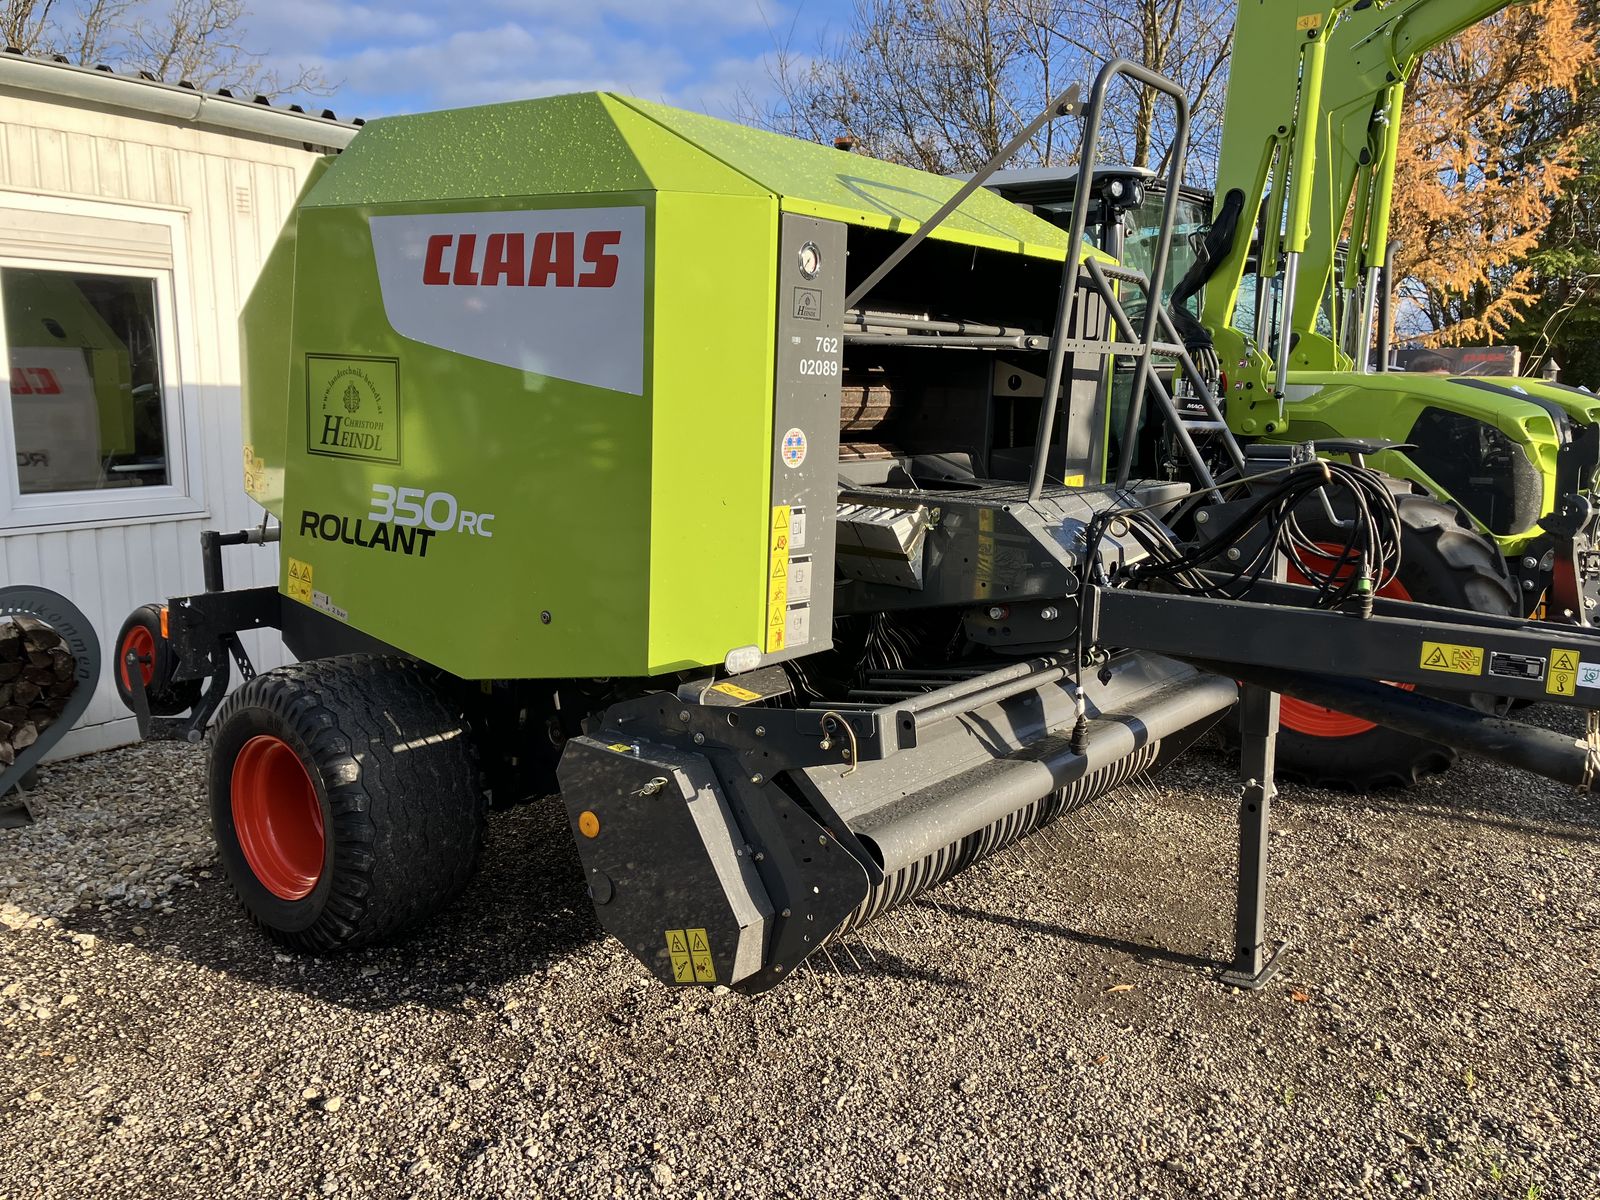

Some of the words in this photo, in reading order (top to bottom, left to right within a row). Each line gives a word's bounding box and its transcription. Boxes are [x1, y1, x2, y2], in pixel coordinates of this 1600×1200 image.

[423, 231, 621, 287] CLAAS
[816, 337, 838, 353] 762
[800, 359, 838, 376] 02089
[320, 414, 382, 451] HEINDL
[344, 416, 384, 431] CHRISTOPH
[368, 483, 458, 532] 350
[458, 510, 495, 538] RC
[300, 510, 436, 558] ROLLANT
